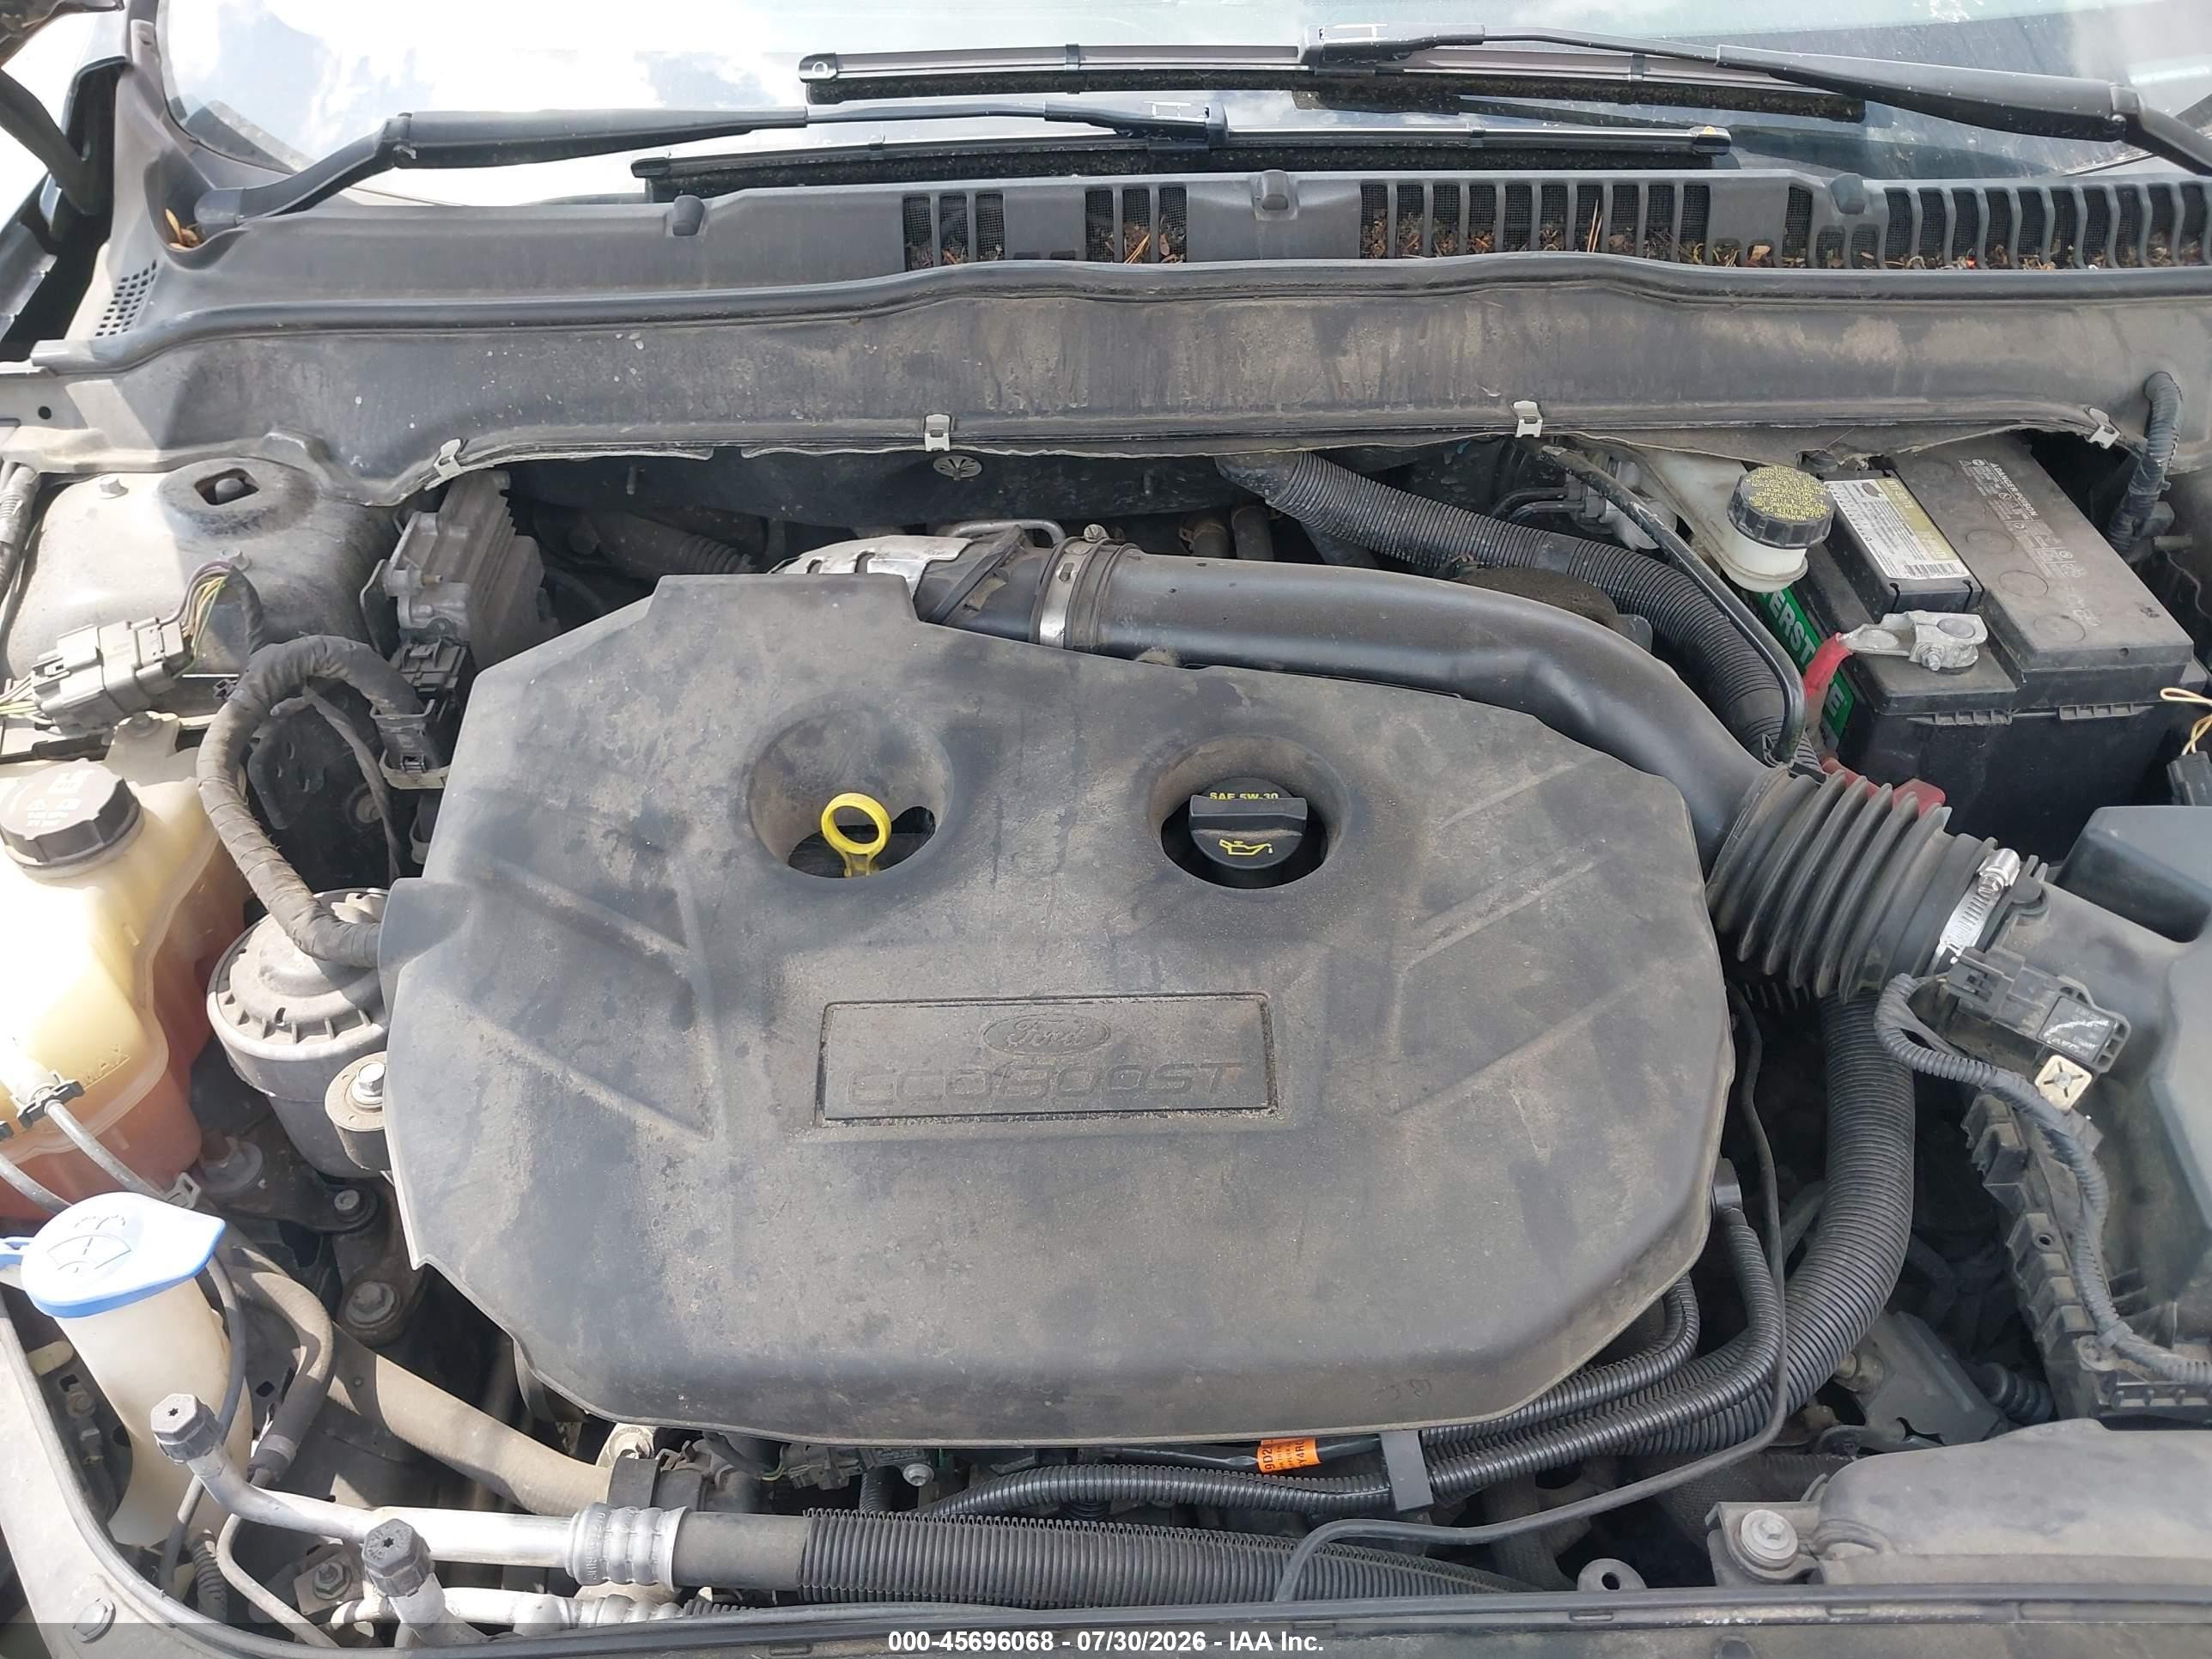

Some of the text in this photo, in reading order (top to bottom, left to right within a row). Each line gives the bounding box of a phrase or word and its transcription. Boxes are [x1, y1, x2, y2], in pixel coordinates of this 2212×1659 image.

[1774, 513, 1807, 521] WARNING
[2013, 493, 2039, 516] POISON
[1003, 1018, 1089, 1048] Ford
[847, 1061, 1243, 1107] ECOBOOST
